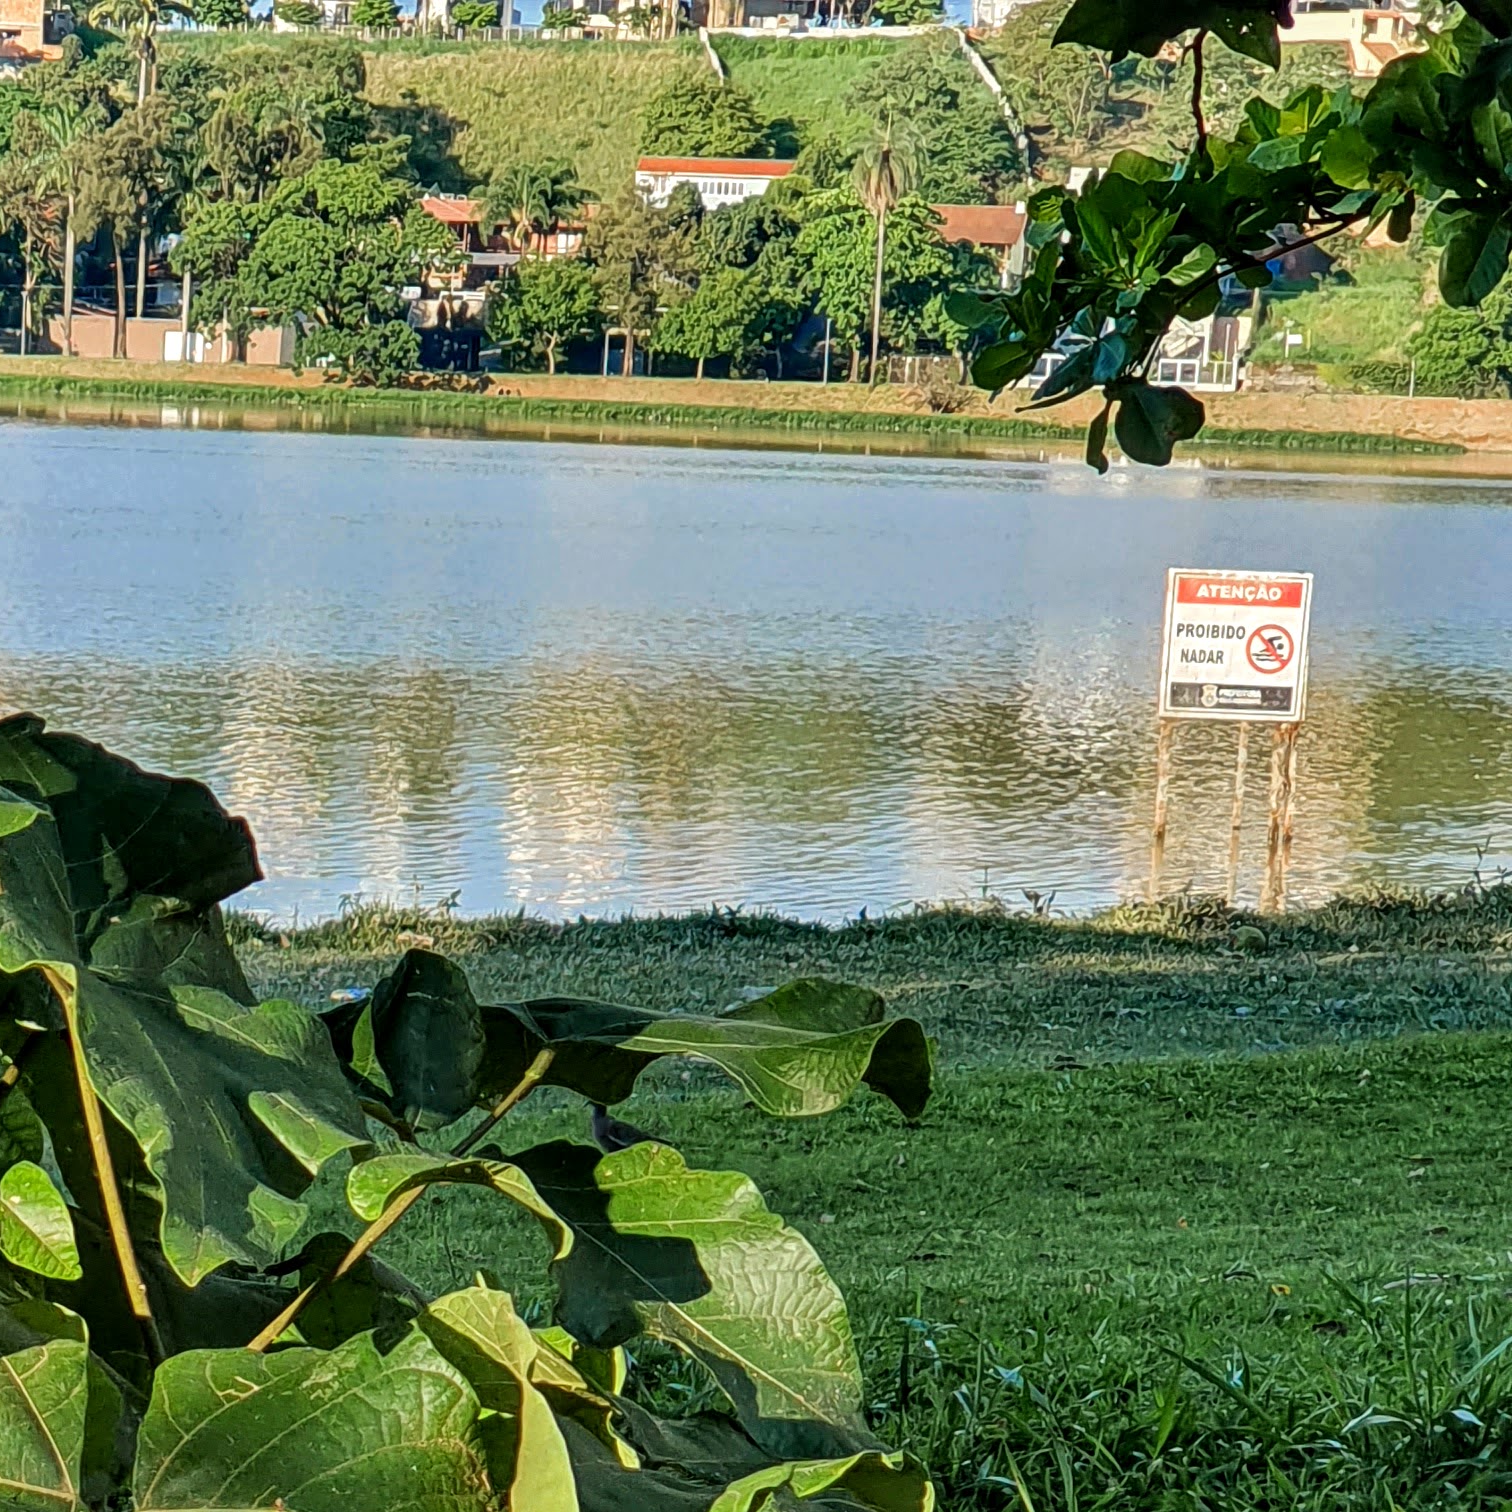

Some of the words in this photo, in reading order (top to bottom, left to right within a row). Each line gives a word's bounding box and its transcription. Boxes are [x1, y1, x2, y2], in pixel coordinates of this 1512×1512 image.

[1196, 582, 1282, 603] ATENÇÃO
[1176, 623, 1246, 640] PROIBIDO
[1180, 648, 1224, 664] NADAR
